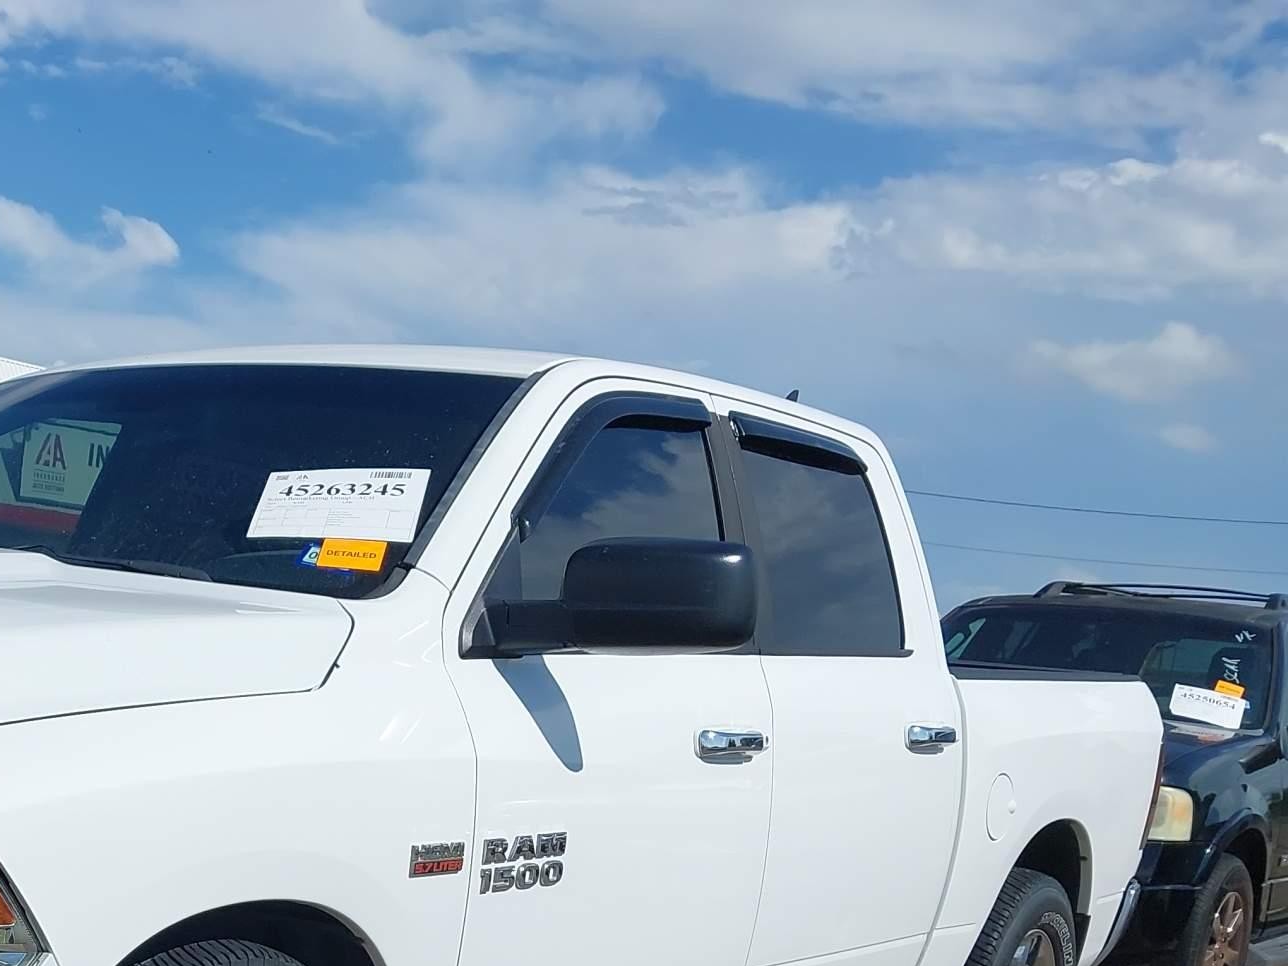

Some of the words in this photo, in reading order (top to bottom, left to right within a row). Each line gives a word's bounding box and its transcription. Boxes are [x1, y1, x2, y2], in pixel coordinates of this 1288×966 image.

[279, 483, 406, 497] 45263245
[326, 549, 377, 559] DETAILED
[482, 832, 567, 865] RAM
[434, 860, 462, 872] LITER
[480, 860, 563, 894] 1500
